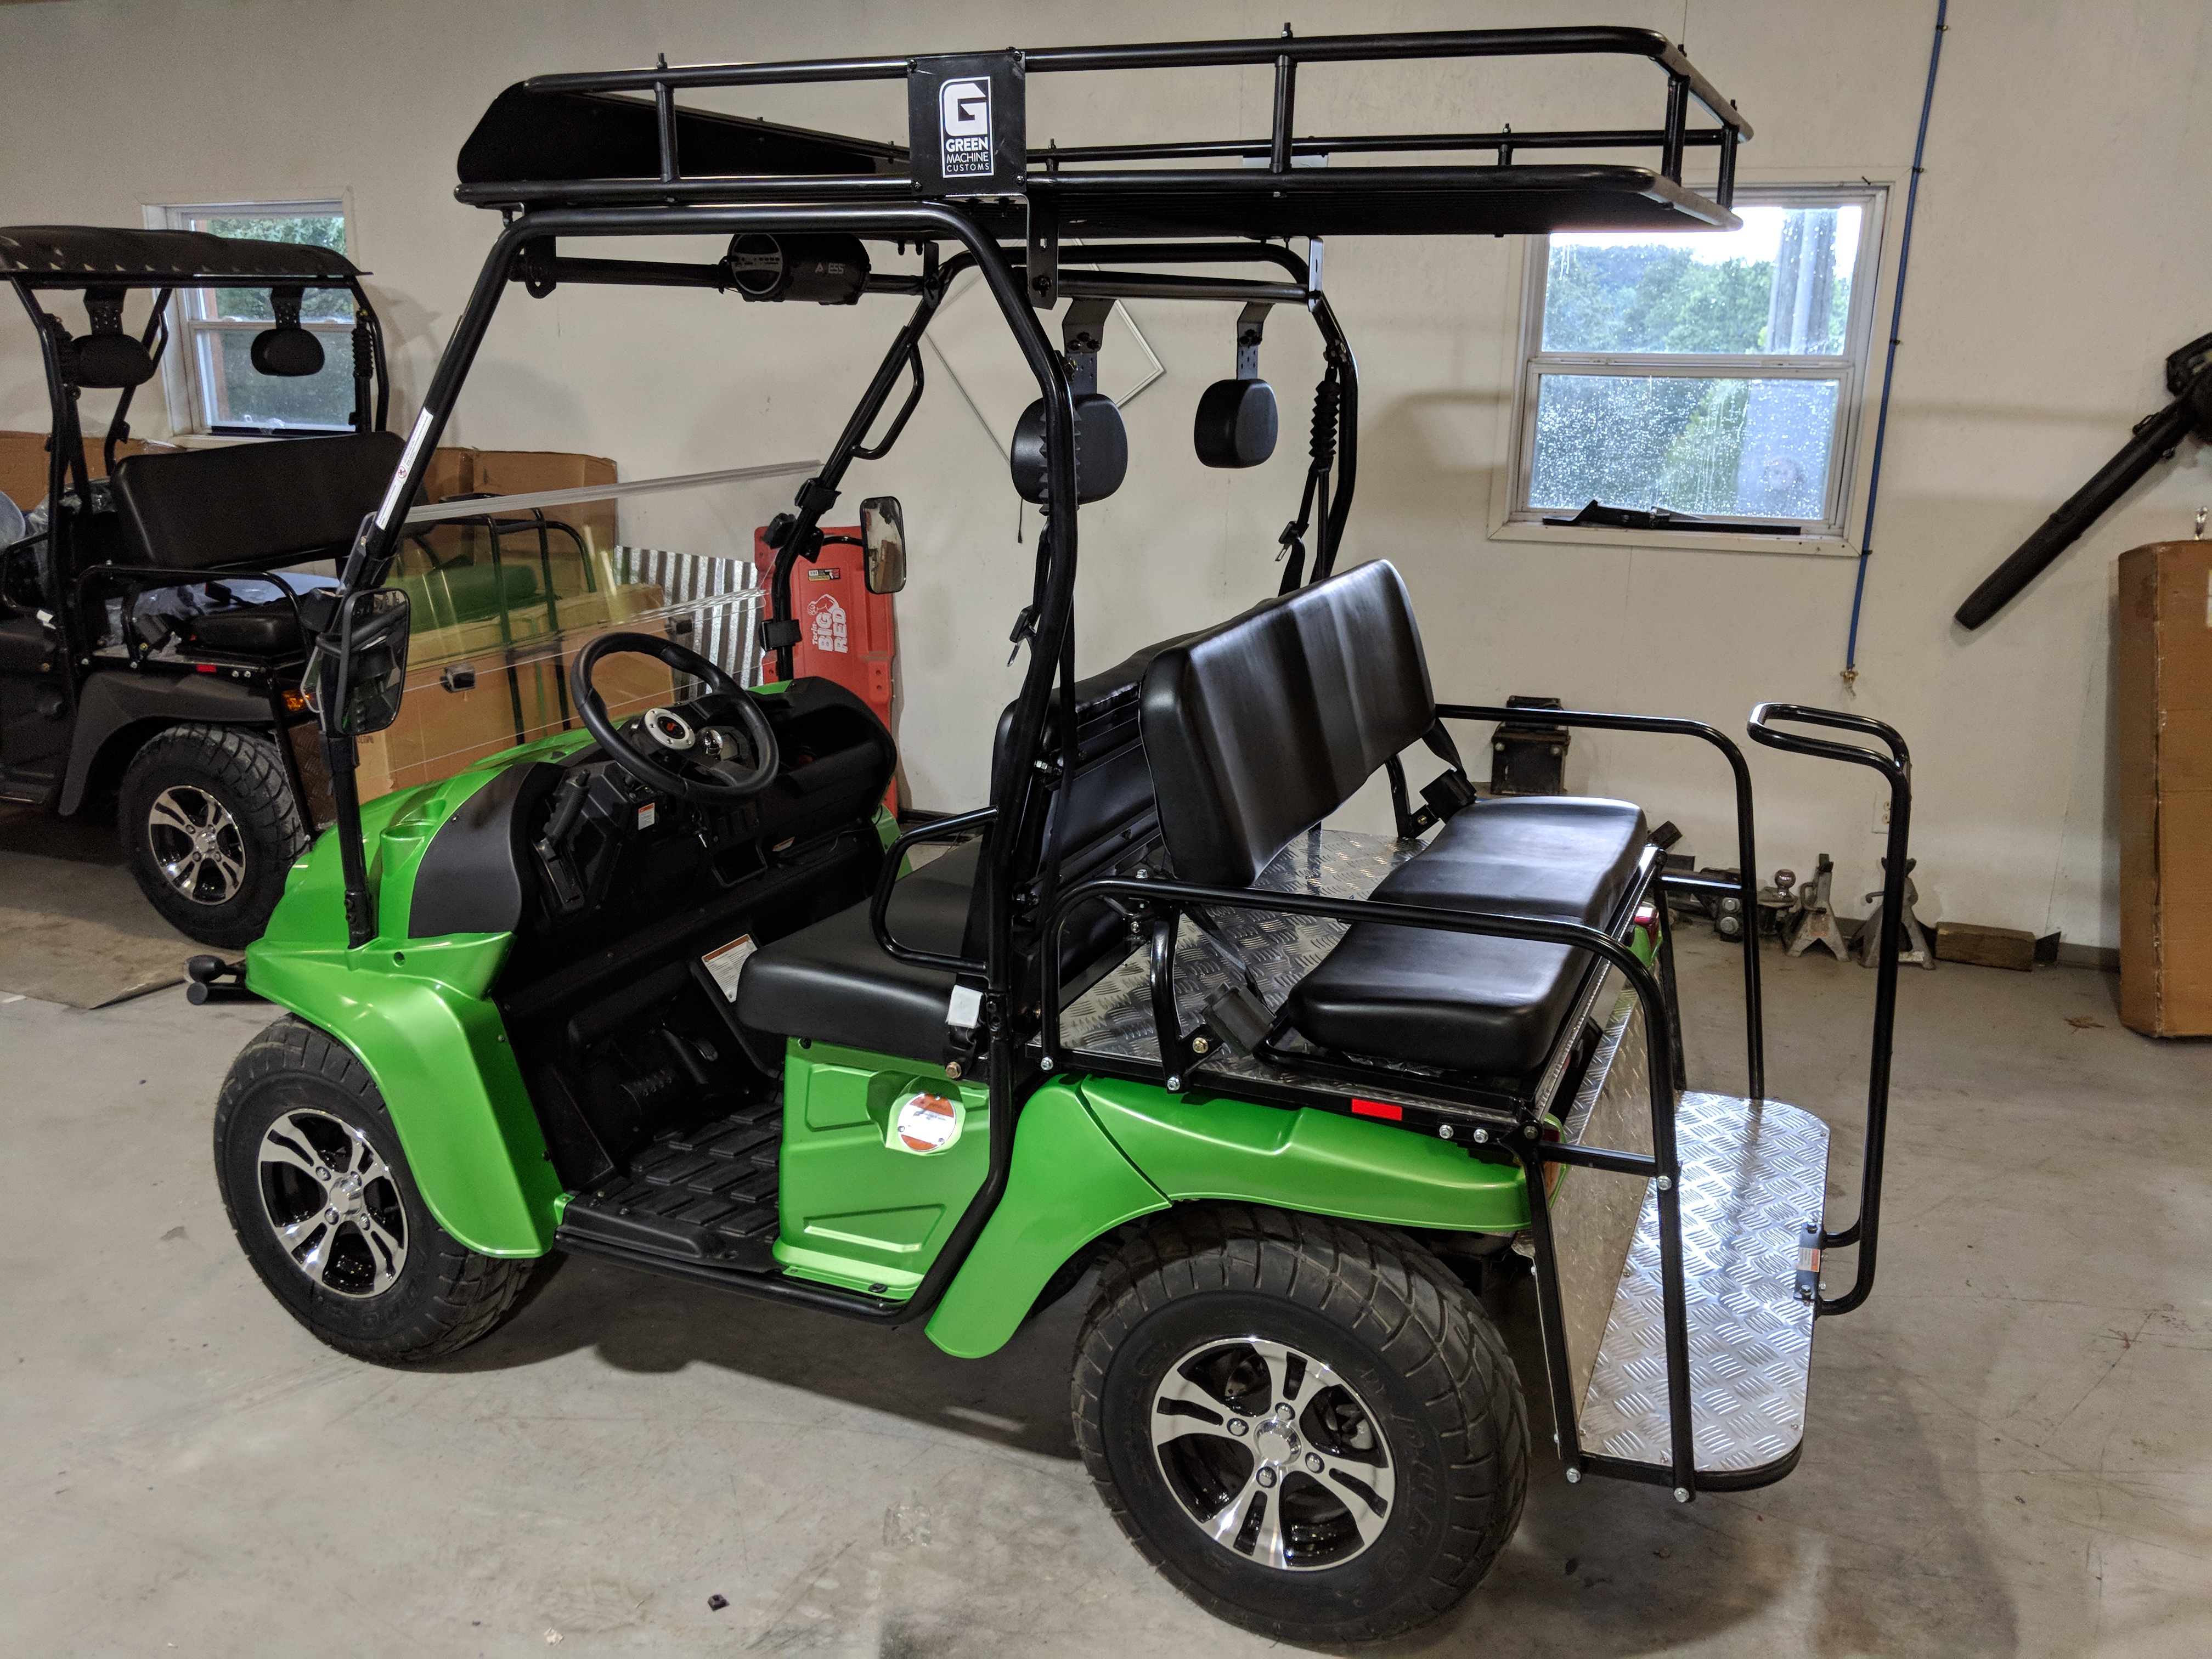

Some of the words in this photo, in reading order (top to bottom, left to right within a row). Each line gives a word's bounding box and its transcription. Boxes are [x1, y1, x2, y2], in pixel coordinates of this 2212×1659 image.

[944, 82, 988, 137] G
[945, 137, 989, 153] GREEN
[946, 151, 989, 164] MACHINE
[946, 162, 990, 172] CUSTOMS
[816, 612, 833, 652] BIG
[833, 607, 848, 653] RED
